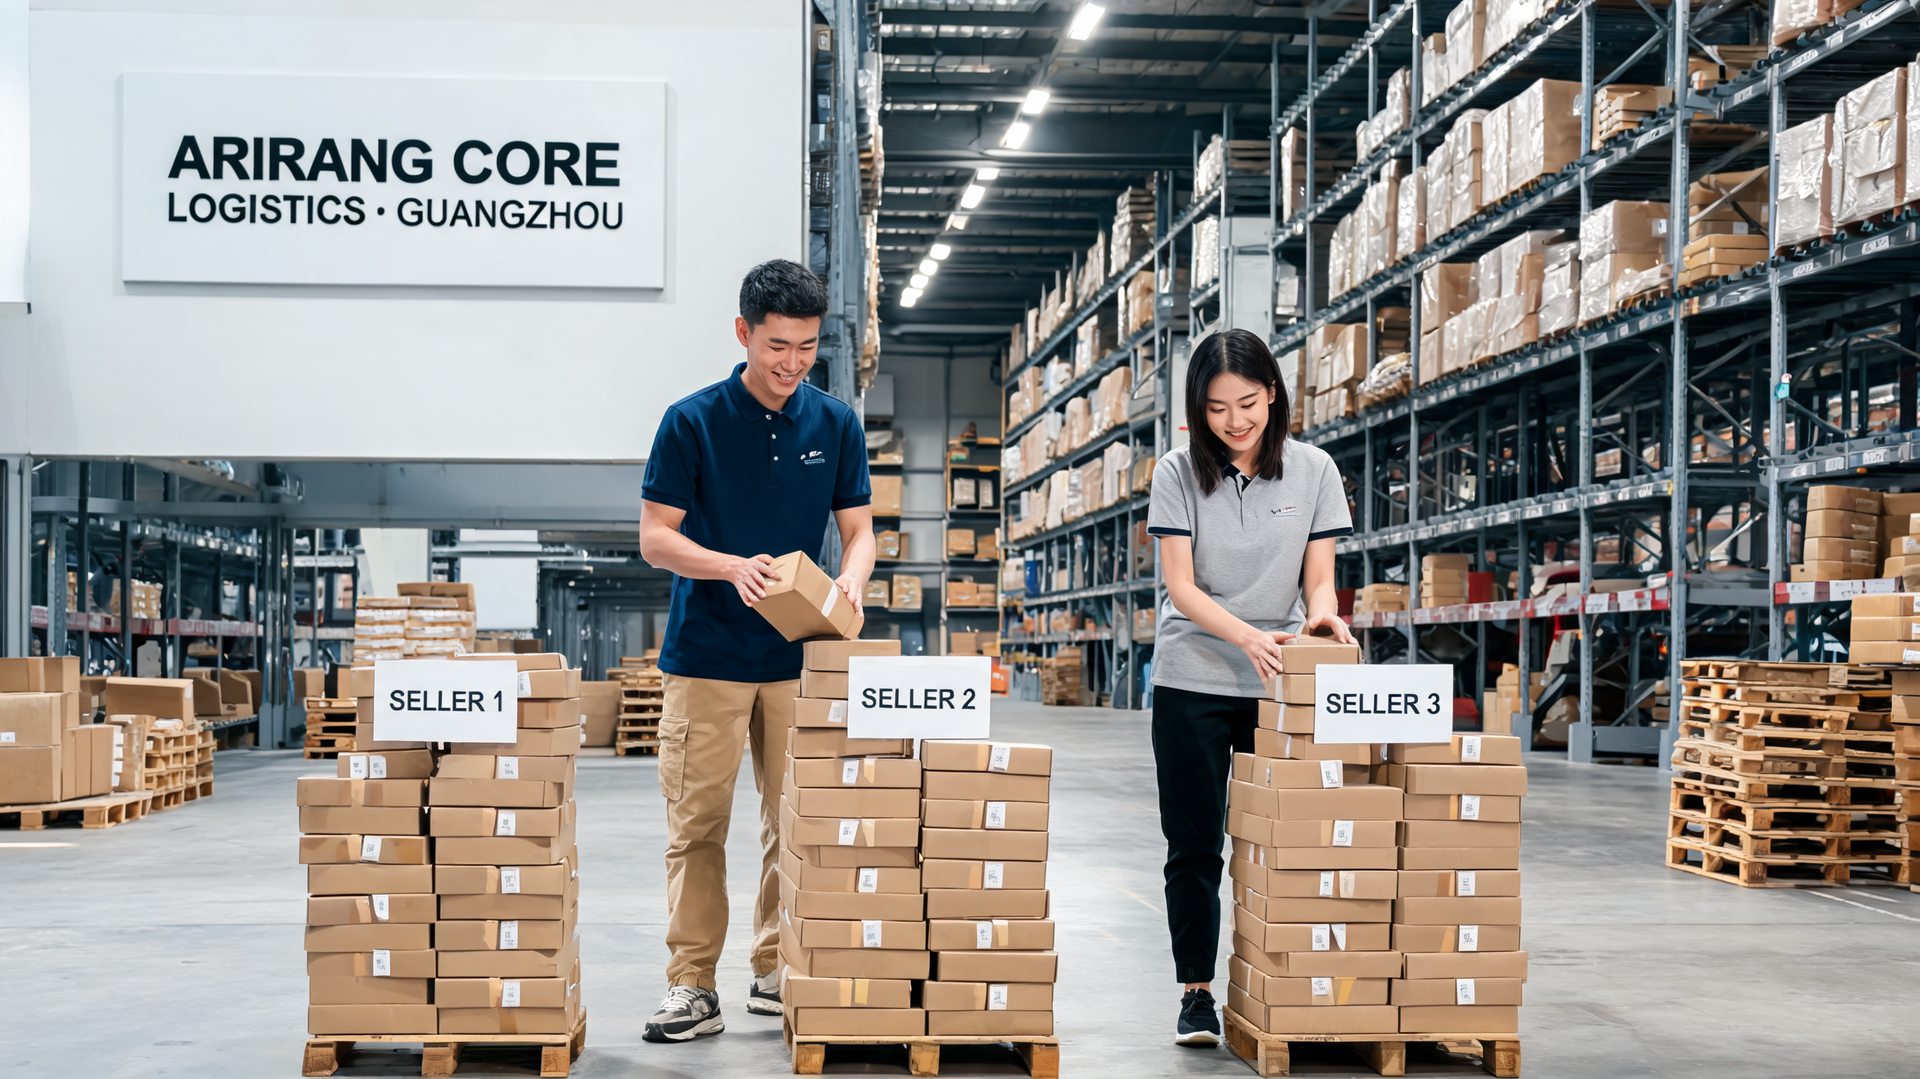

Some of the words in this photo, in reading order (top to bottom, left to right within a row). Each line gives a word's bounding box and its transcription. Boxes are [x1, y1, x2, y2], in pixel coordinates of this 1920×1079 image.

[167, 135, 433, 184] ARIRANG
[453, 139, 620, 187] CORE
[168, 192, 366, 226] LOGISTICS
[397, 197, 623, 230] GUANGZHOU
[389, 689, 485, 712] SELLER
[493, 690, 502, 712] 1
[861, 687, 955, 710] SELLER
[961, 688, 976, 710] 2
[1326, 693, 1420, 715] SELLER
[1427, 692, 1441, 715] 3
